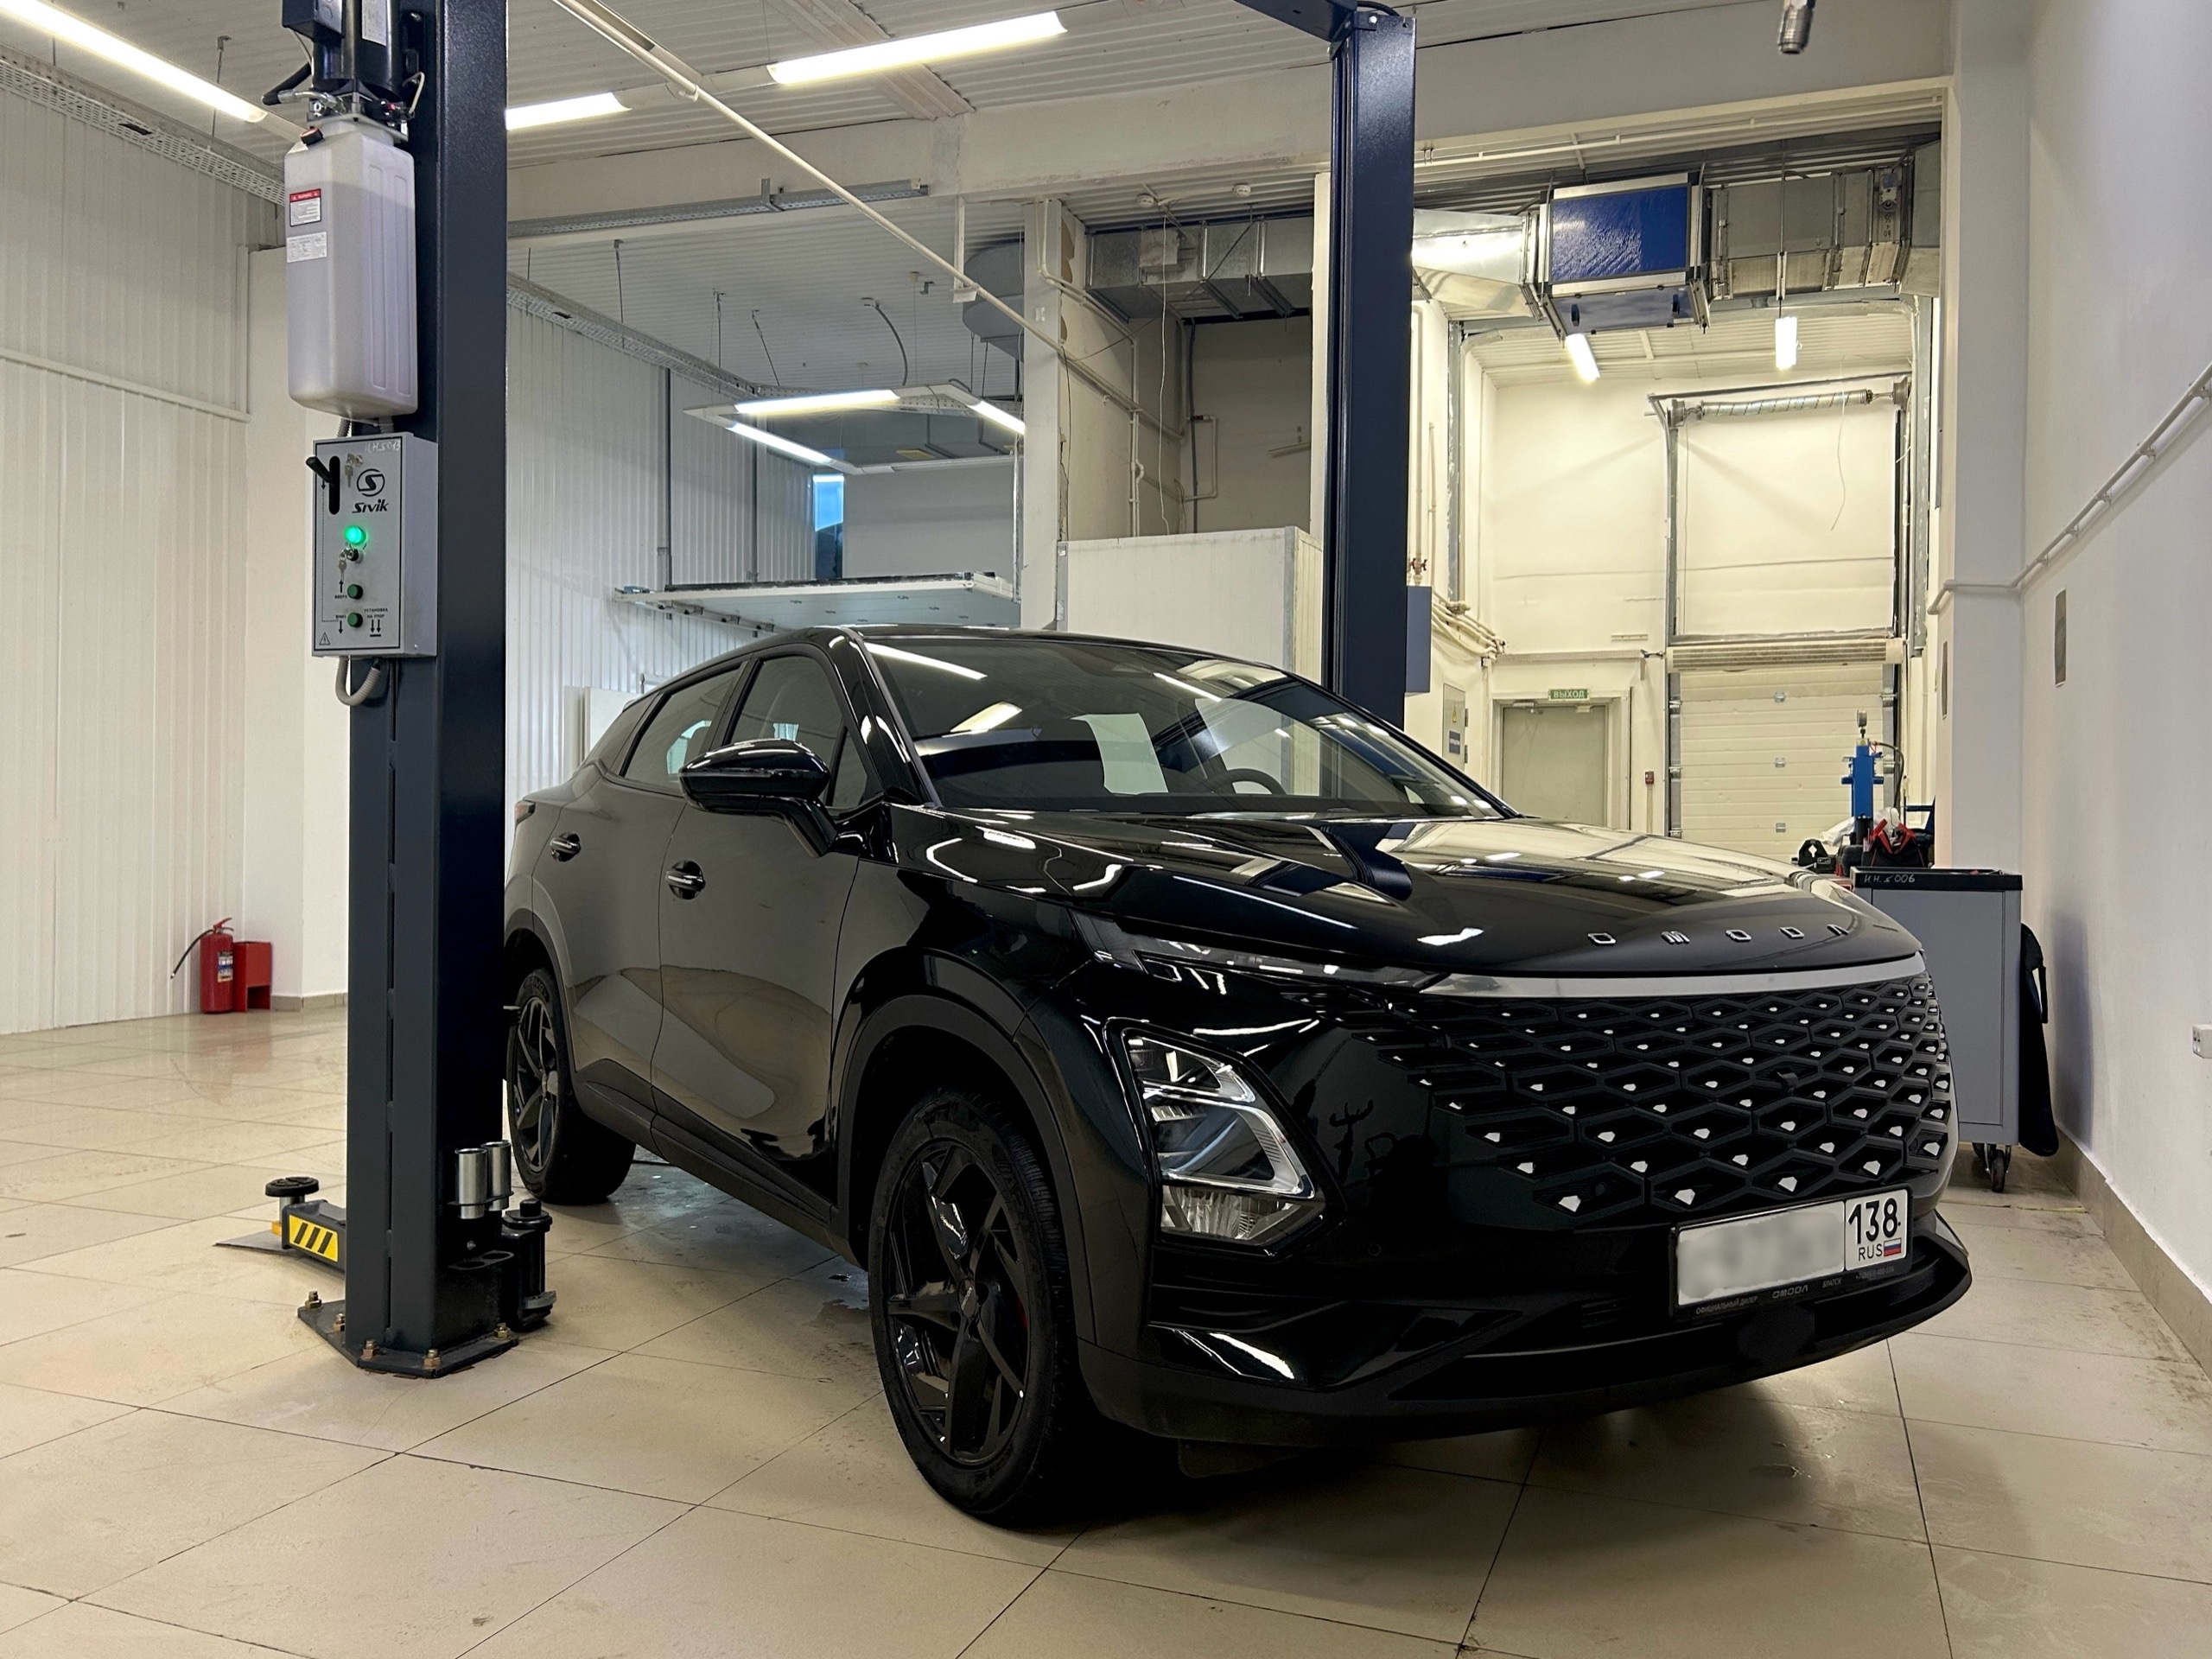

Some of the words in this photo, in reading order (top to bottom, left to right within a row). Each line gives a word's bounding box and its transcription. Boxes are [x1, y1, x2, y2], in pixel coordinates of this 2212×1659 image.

[352, 499, 389, 513] Sivik
[1848, 1198, 1898, 1244] 138
[1859, 1243, 1883, 1262] RUS
